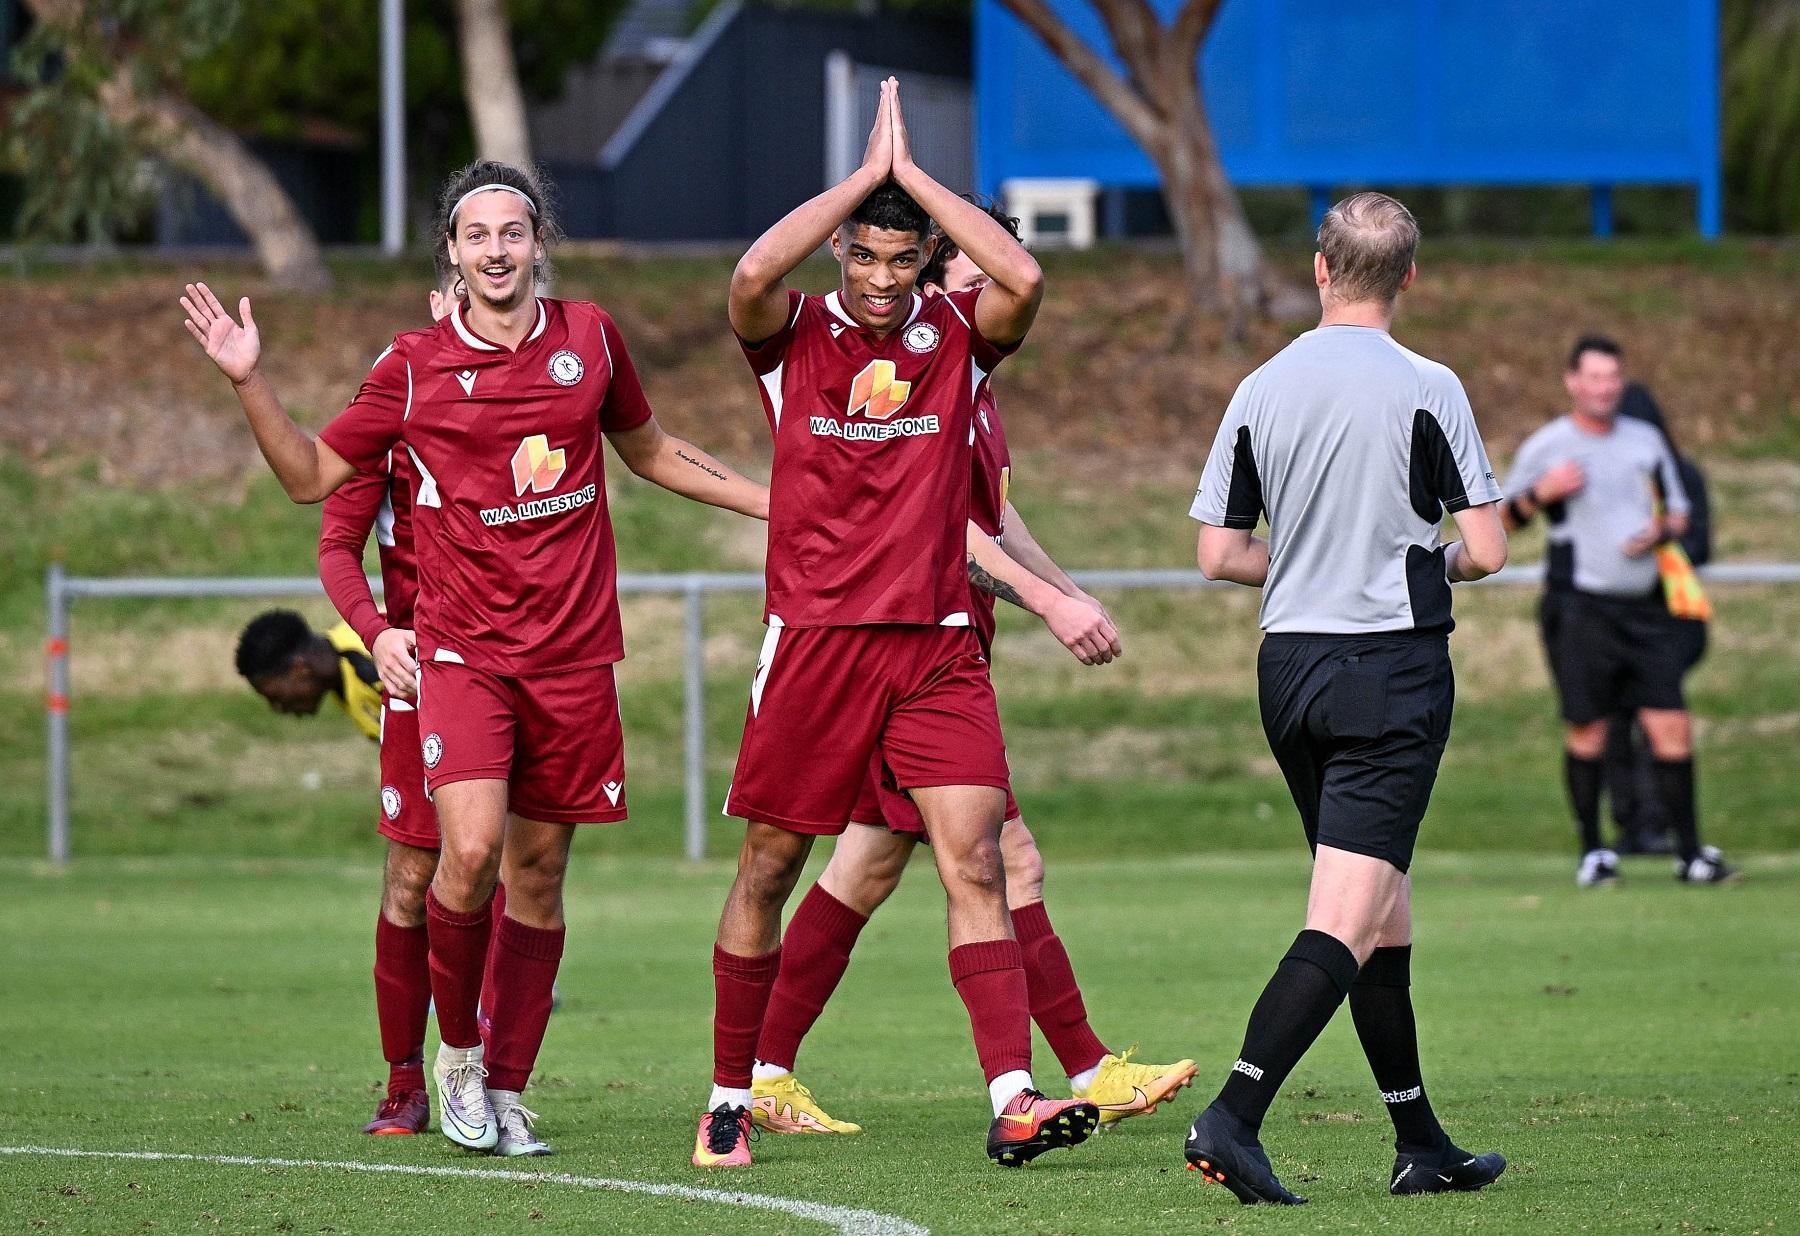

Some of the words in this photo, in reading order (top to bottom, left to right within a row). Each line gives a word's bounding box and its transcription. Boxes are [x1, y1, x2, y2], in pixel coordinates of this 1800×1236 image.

[810, 418, 843, 435] W.A.
[845, 417, 938, 439] LIMESTONE
[481, 508, 518, 525] W.A.
[519, 484, 596, 518] LIMESTONE
